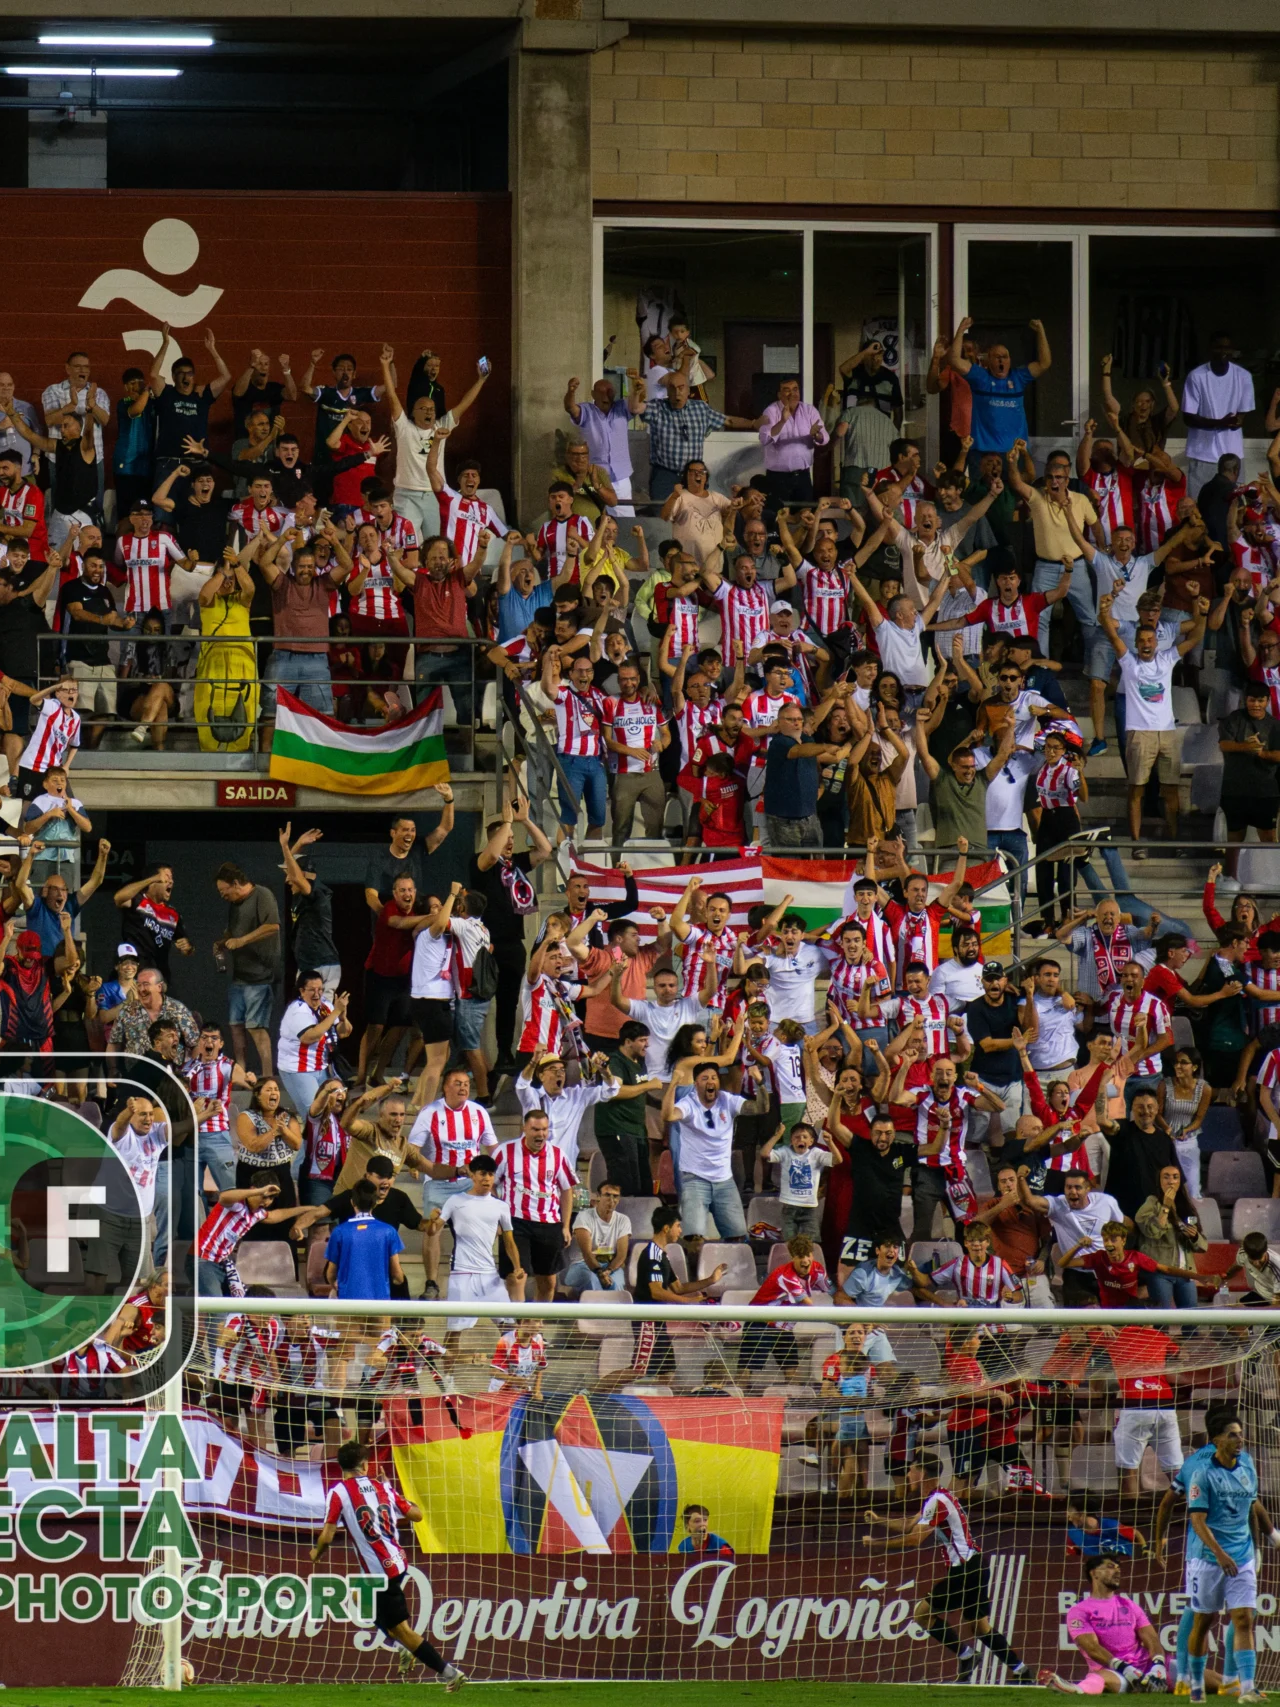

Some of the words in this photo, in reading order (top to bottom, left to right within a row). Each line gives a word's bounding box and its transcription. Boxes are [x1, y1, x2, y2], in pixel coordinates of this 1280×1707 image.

[883, 334, 899, 367] 8
[225, 786, 288, 801] SALIDA
[356, 1503, 396, 1544] 20
